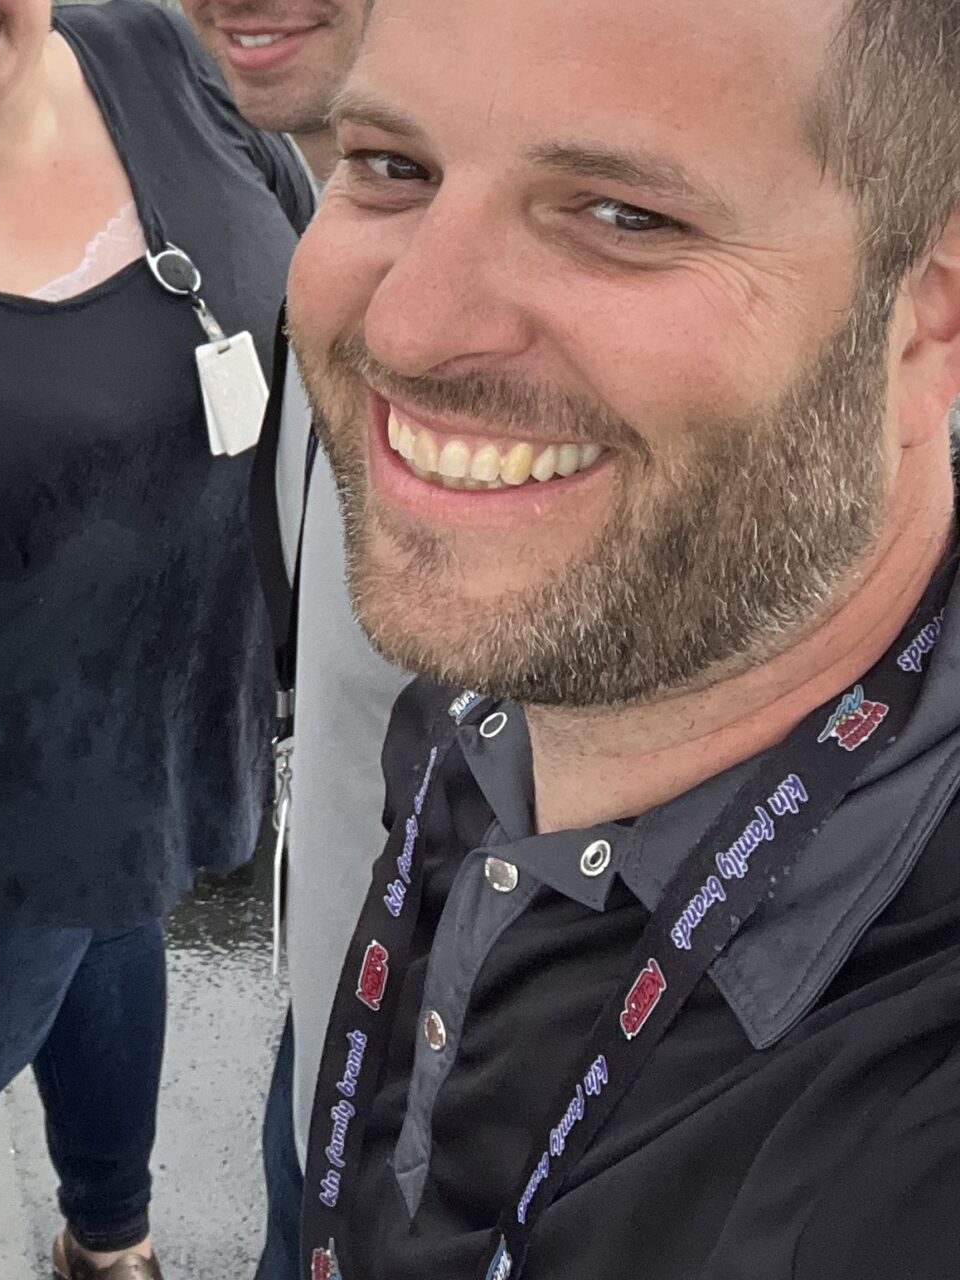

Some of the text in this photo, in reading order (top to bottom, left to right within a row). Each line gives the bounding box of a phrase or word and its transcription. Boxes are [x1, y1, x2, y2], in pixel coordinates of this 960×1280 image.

[897, 608, 945, 673] ands
[671, 773, 809, 950] kln family brands
[319, 1029, 368, 1208] kln family brands
[584, 1054, 608, 1096] kln
